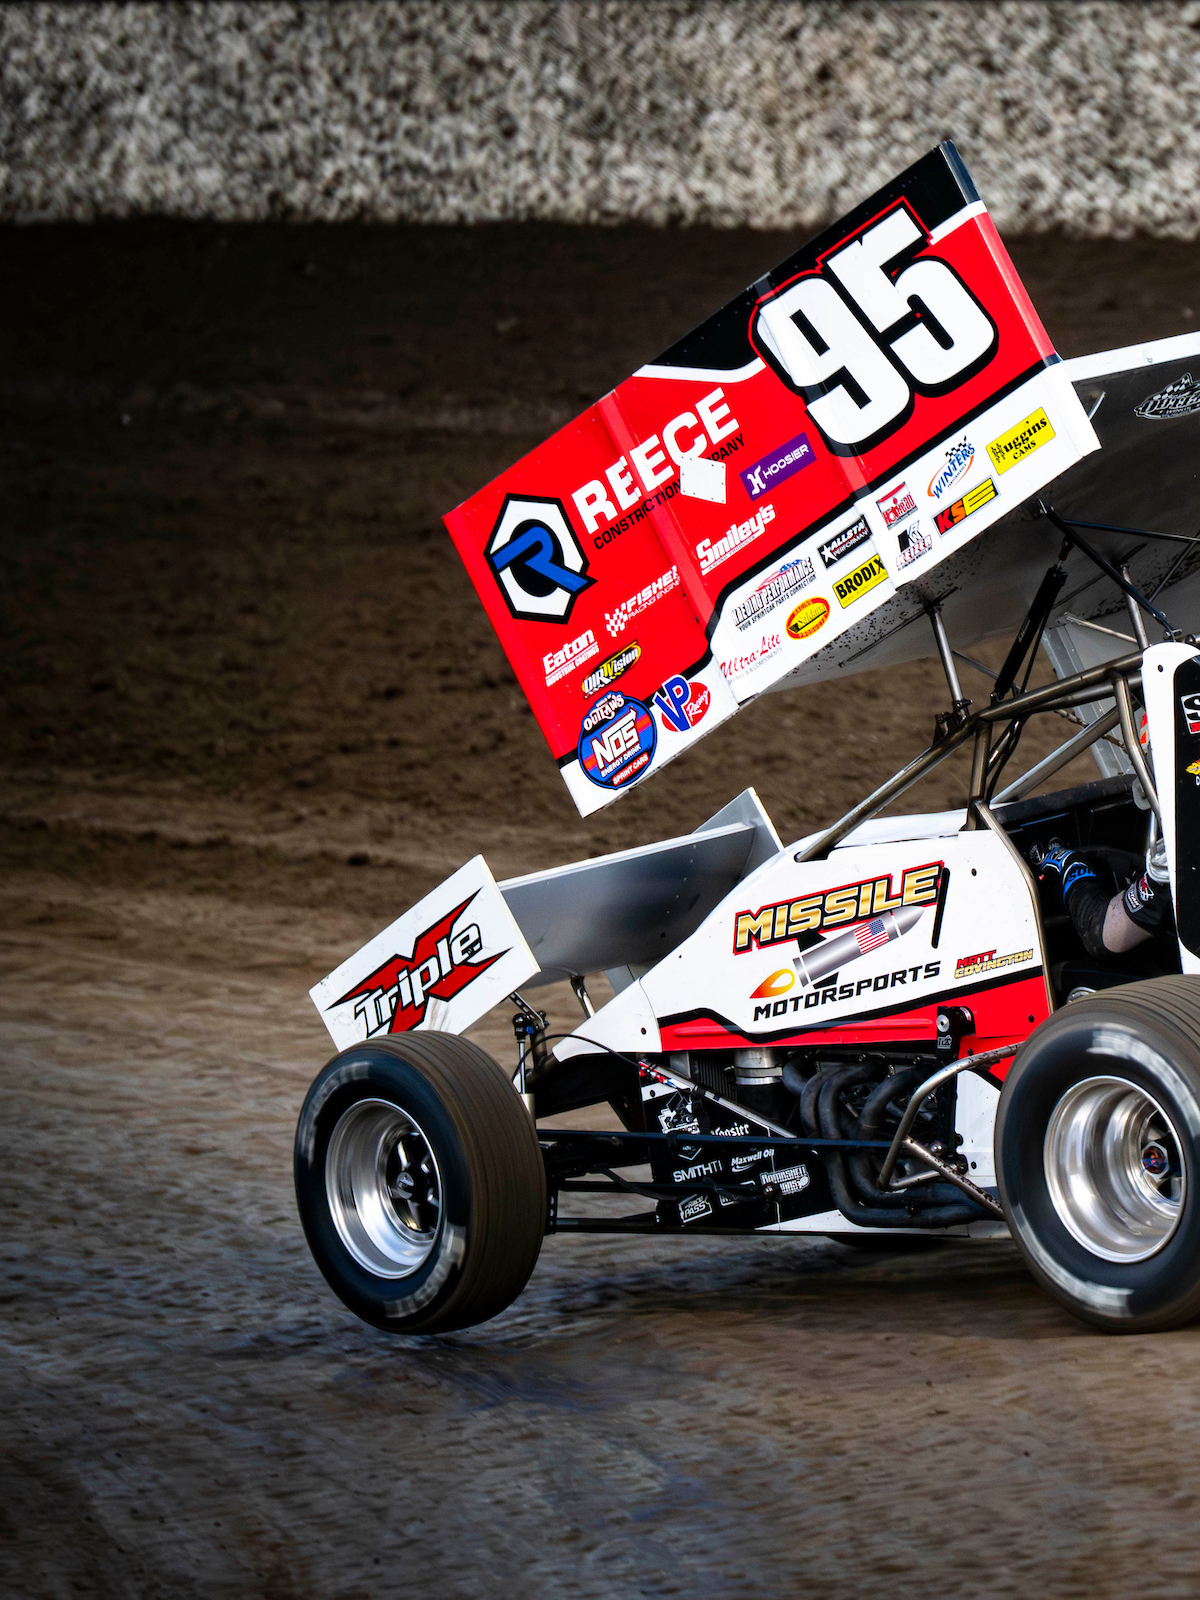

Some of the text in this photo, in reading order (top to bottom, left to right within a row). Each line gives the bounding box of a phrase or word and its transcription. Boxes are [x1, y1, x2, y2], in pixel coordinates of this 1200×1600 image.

[754, 204, 997, 447] 95
[571, 387, 740, 535] REECE
[706, 433, 745, 462] PANY
[762, 443, 810, 479] HOOSIER
[990, 417, 1048, 464] Huggins
[1013, 440, 1037, 460] CAMS
[933, 443, 976, 499] WINTERS
[936, 477, 998, 535] KSE
[696, 504, 776, 571] Smiley's
[830, 519, 867, 551] ALLSTA
[833, 529, 869, 556] PERFORMAN
[761, 556, 815, 606] PERFORMANCE
[835, 558, 887, 600] BRODIX
[628, 596, 657, 620] RACING
[738, 620, 752, 632] YOUR
[775, 593, 790, 607] PARTS
[542, 629, 596, 675] Eaton
[545, 643, 600, 687] INDUSTRIAL COATINGS
[719, 634, 782, 679] Ultra-Lite
[583, 694, 625, 731] OUTLAWS
[653, 674, 709, 732] VP Racing
[591, 707, 640, 771] NOS
[600, 743, 642, 778] ENERGY DRINK
[613, 753, 649, 786] SPRINT CARS
[734, 862, 942, 951] MISSILE
[954, 948, 1034, 979] COVINGTON
[957, 948, 997, 969] MATT
[354, 923, 483, 1039] Triple
[753, 961, 942, 1022] MOTORSPORTS
[731, 1148, 775, 1167] Maxwell Oil
[684, 1203, 706, 1219] PASS
